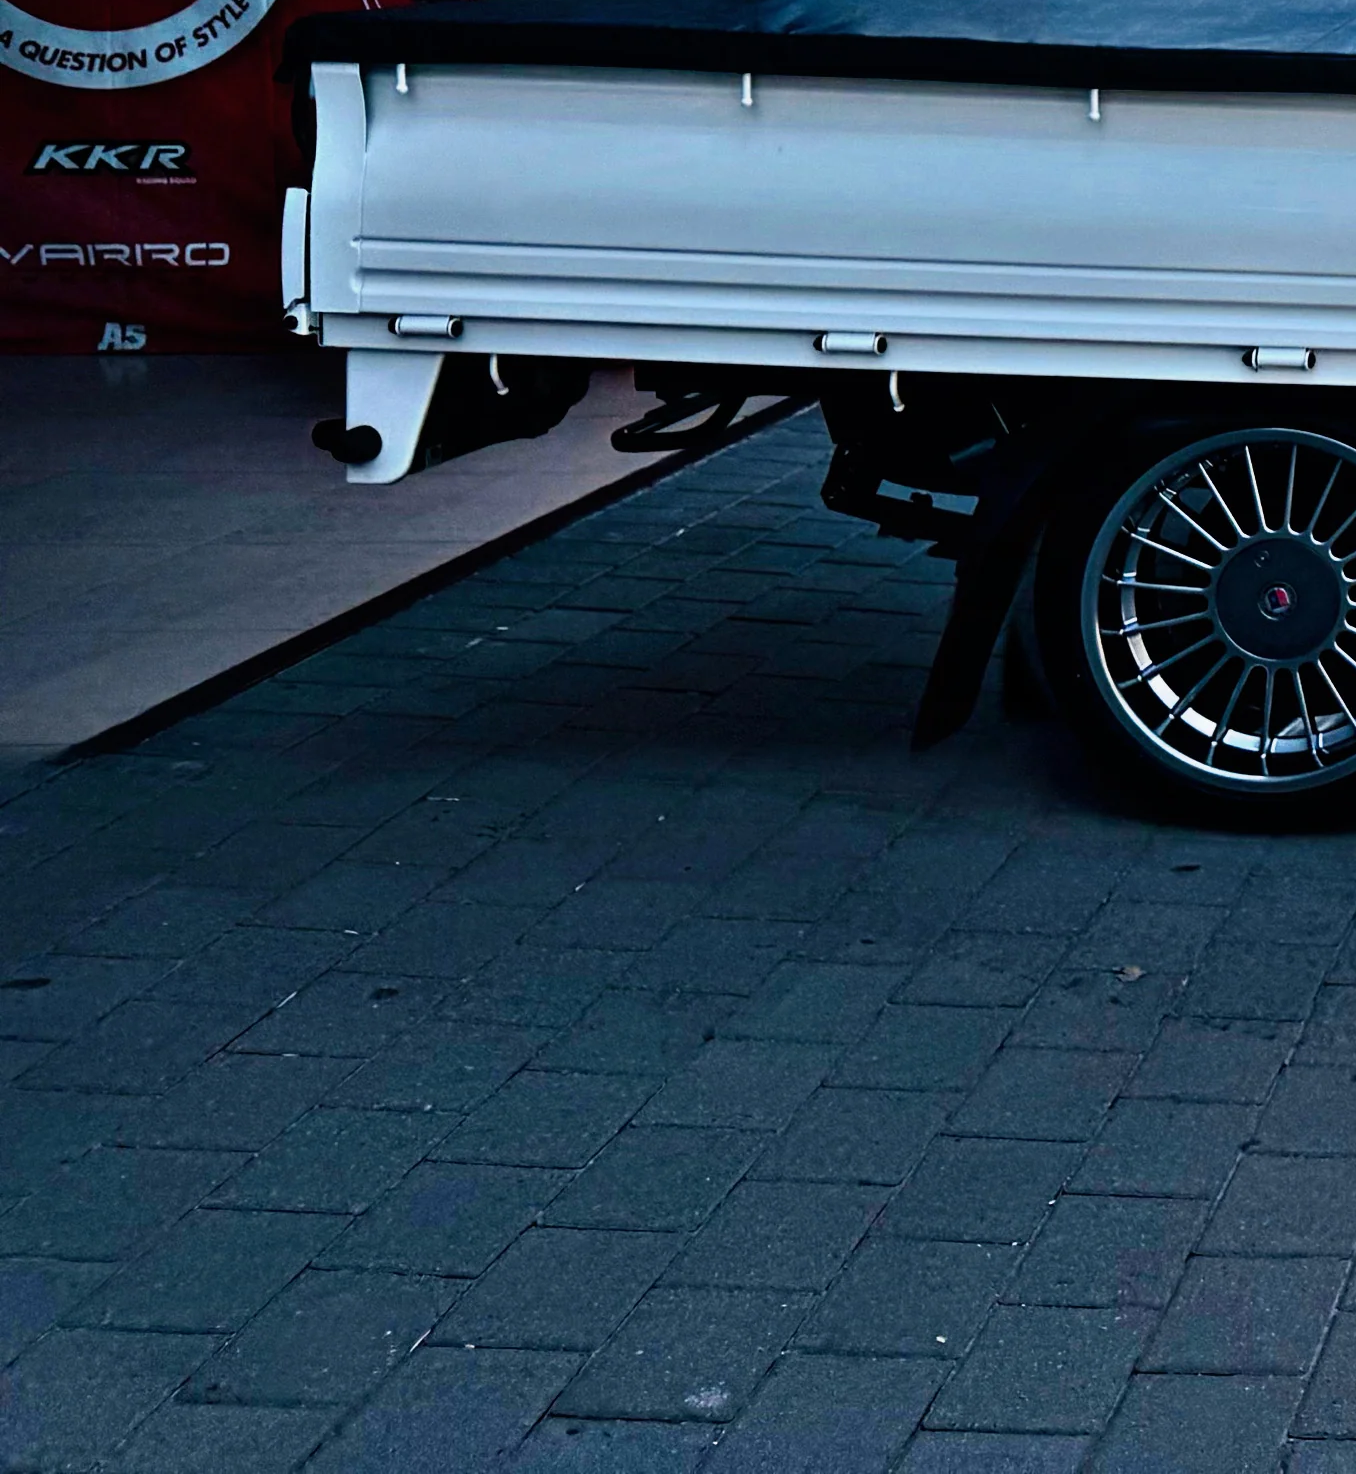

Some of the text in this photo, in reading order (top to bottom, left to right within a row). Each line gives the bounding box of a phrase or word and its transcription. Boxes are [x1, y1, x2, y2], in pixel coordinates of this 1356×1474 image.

[19, 40, 148, 72] QUESTION
[155, 37, 189, 63] OF
[33, 144, 186, 169] KKR
